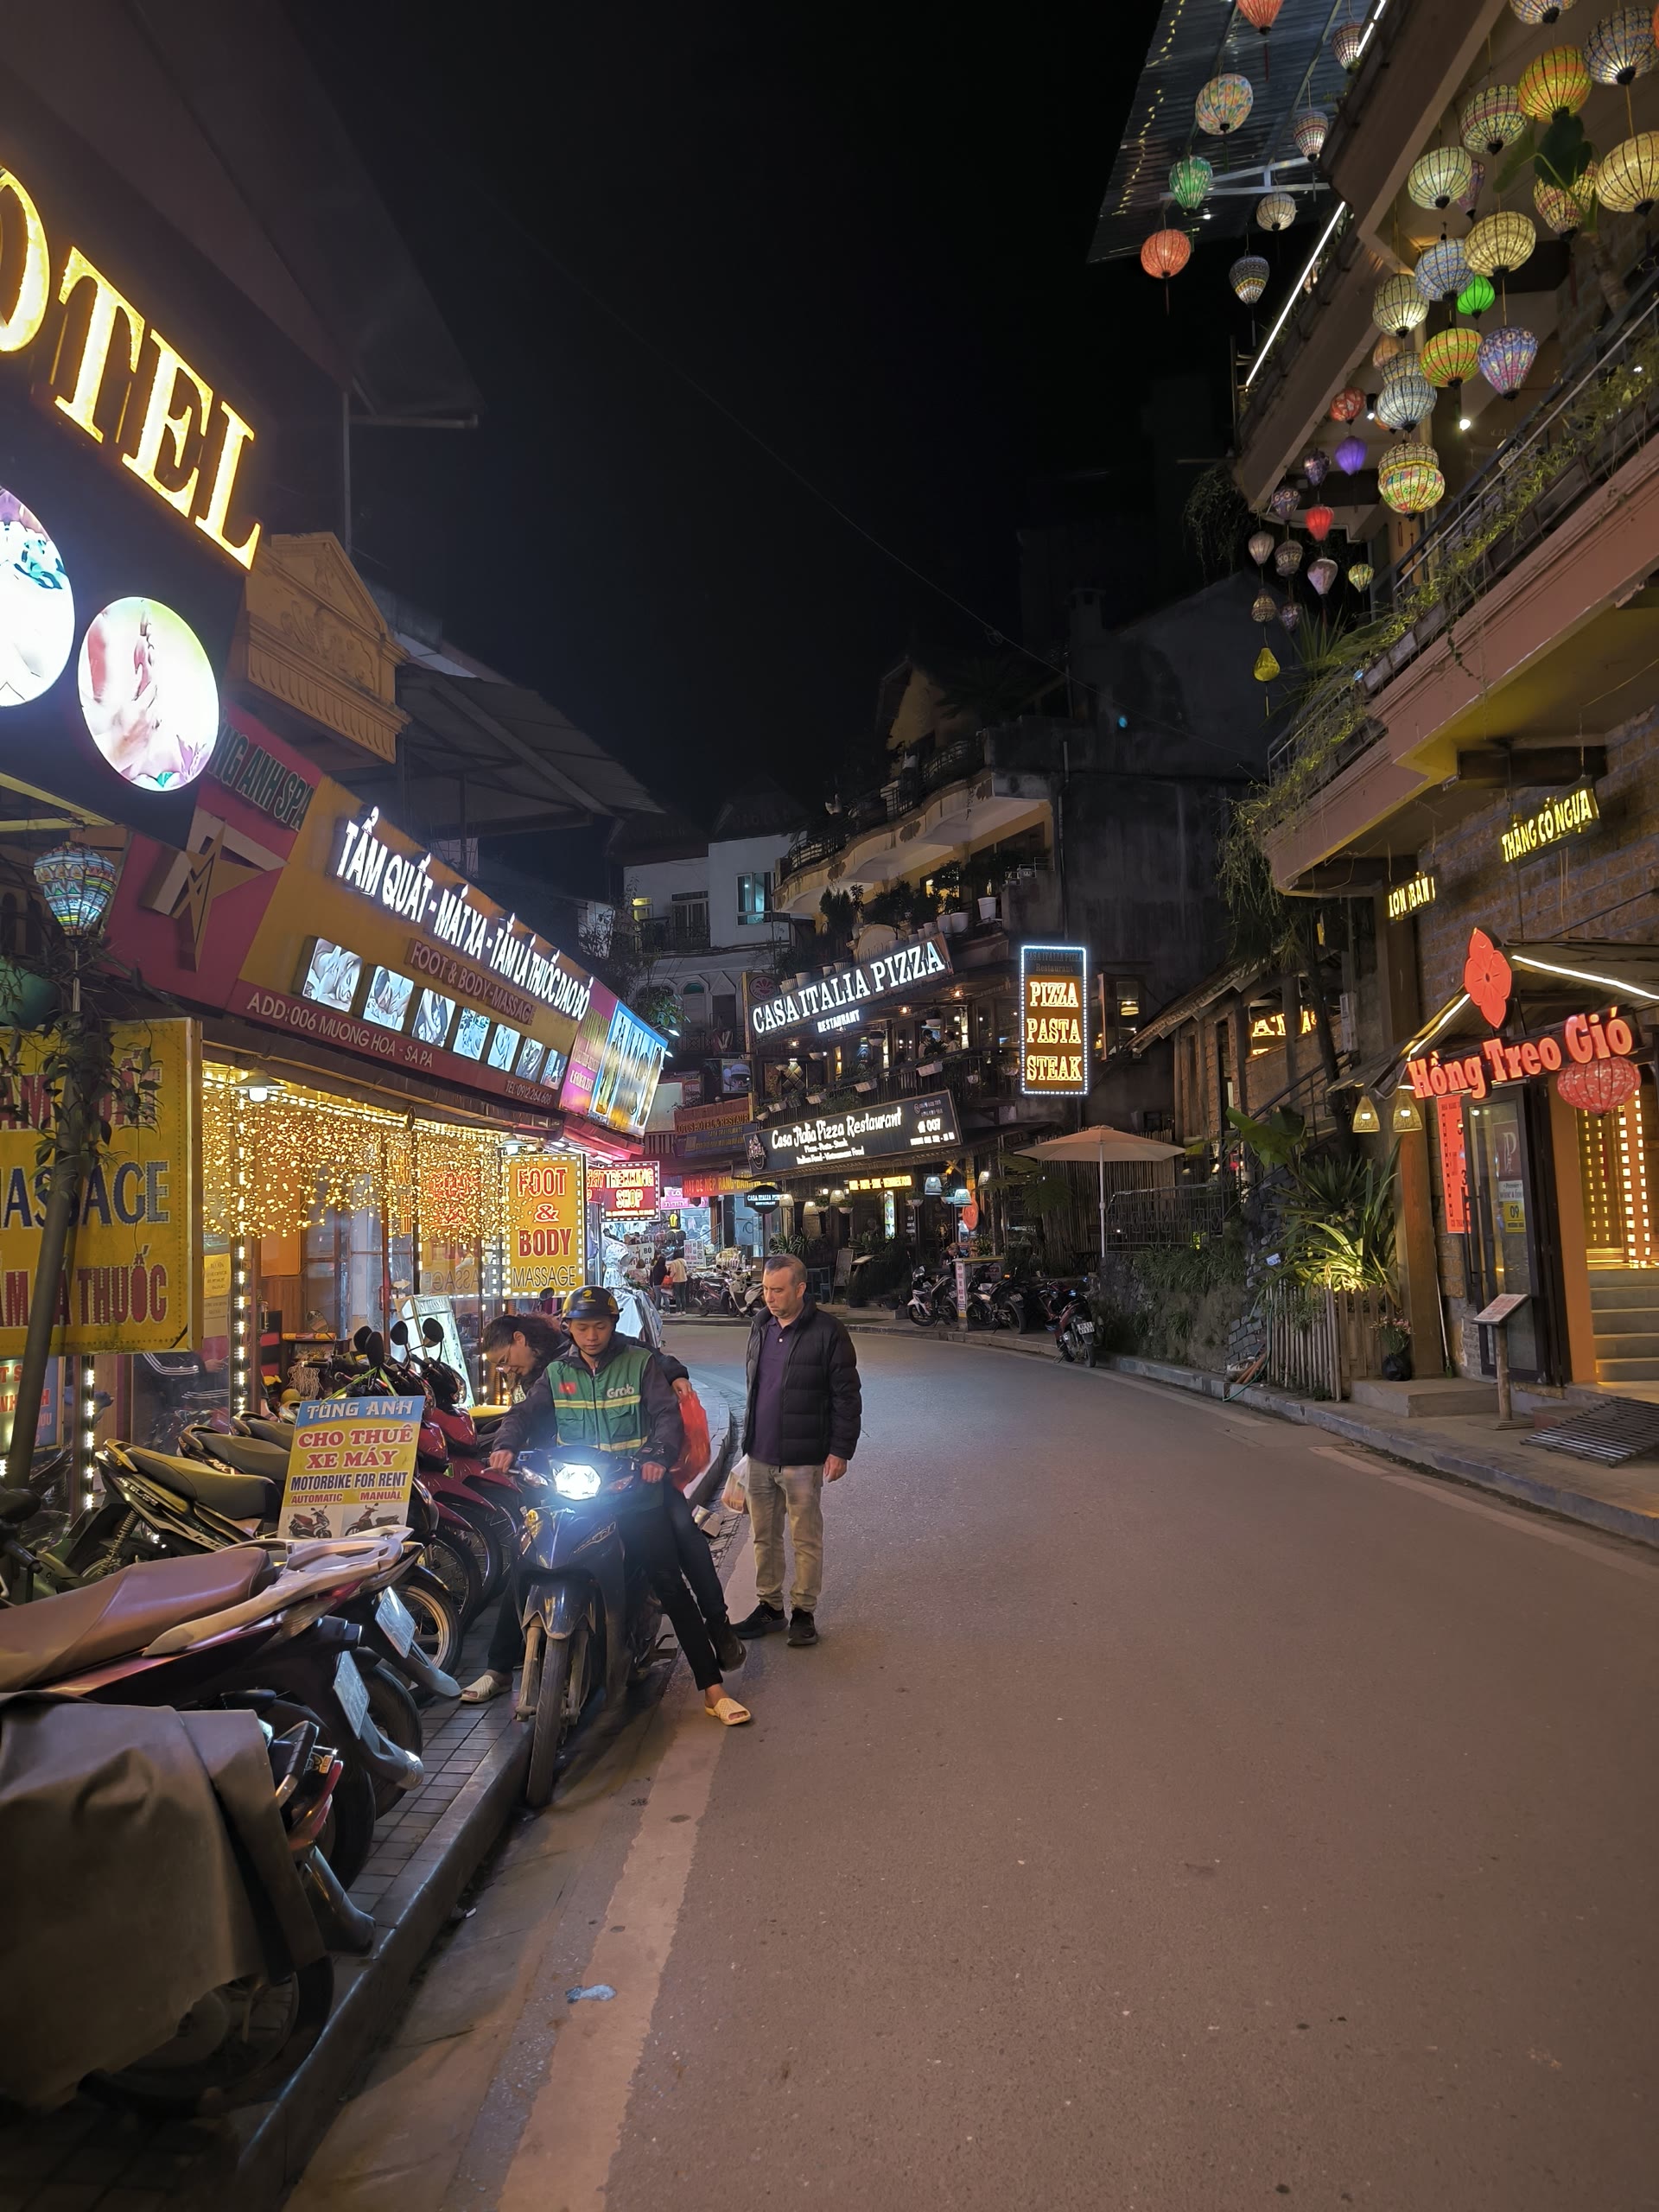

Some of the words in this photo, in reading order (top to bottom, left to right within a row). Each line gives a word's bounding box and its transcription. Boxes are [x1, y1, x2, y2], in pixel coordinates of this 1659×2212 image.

[235, 746, 287, 812] ANH
[274, 772, 315, 832] SPA
[434, 884, 472, 948] MÁT
[464, 909, 487, 960] XA
[410, 942, 449, 978] FOOT
[448, 963, 457, 984] &
[1036, 963, 1073, 972] Restaurant
[753, 995, 799, 1033] CASA
[798, 969, 870, 1018] ITALIA
[870, 941, 945, 992] PIZZA
[1030, 982, 1078, 1007] PIZZA
[817, 1009, 861, 1033] RESTAURANT
[1027, 1018, 1081, 1044] PASTA
[318, 1015, 369, 1047] MUONG
[371, 1033, 395, 1057] HOA
[405, 1045, 418, 1064] SA
[420, 1047, 434, 1068] PA
[1407, 1051, 1486, 1099] Hồng
[1482, 1038, 1562, 1082] Treo
[1565, 1006, 1633, 1065] Gió
[1027, 1055, 1082, 1081] STEAK
[694, 1118, 714, 1131] HOTEL
[771, 1129, 792, 1149] Casa
[816, 1120, 845, 1143] Pizza
[846, 1106, 902, 1138] Restaurant
[518, 1167, 568, 1197] FOOT
[615, 1189, 643, 1208] SHOP
[535, 1204, 559, 1222] &
[518, 1227, 573, 1257] BODY
[76, 1243, 168, 1327] THUỐC
[512, 1266, 575, 1287] MASSAGE
[607, 1383, 635, 1398] Grab
[366, 1401, 413, 1415] ANH
[298, 1430, 345, 1447] CHO
[350, 1424, 413, 1444] THUÊ
[306, 1452, 339, 1469] XE
[343, 1446, 398, 1467] MÁY
[290, 1473, 353, 1491] MOTORBIKE
[354, 1472, 377, 1489] FOR
[378, 1471, 409, 1488] RENT
[290, 1492, 343, 1504] AUTOMATIC
[359, 1491, 403, 1502] MANUAL
